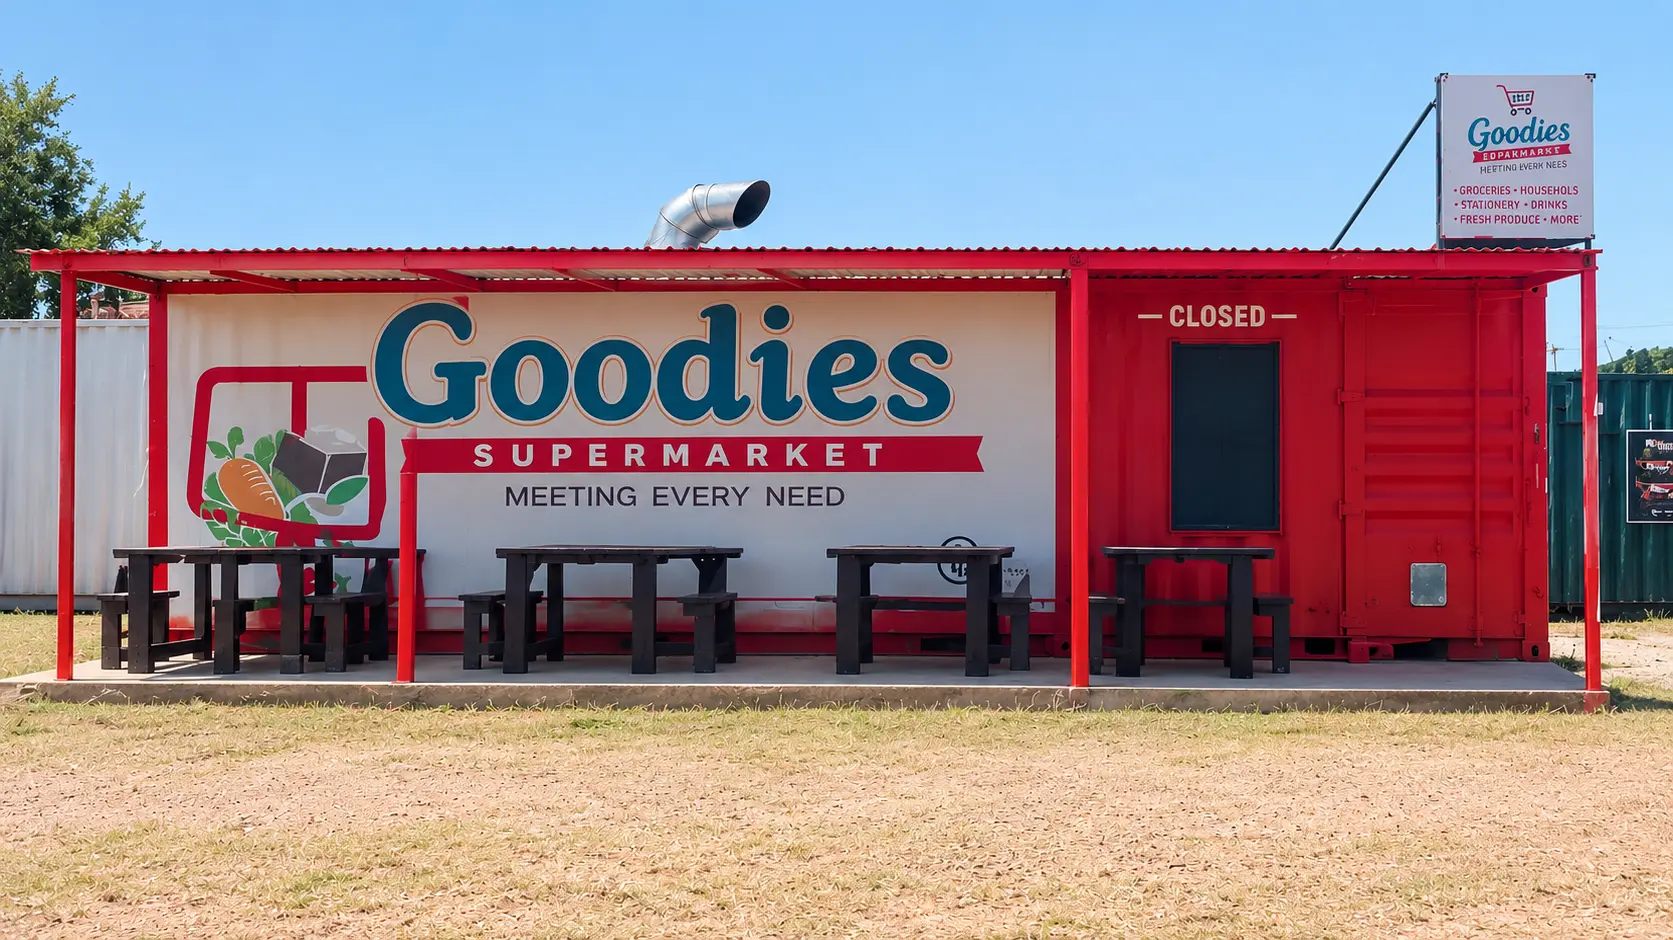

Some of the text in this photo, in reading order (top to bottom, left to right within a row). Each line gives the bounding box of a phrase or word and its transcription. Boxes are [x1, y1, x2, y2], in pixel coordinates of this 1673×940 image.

[1467, 116, 1570, 151] Goodies
[1459, 185, 1579, 195] GROCERIES HOUSEHOLS
[1461, 200, 1568, 209] STATIONERY DRINKS
[1460, 215, 1491, 224] FRESH
[1494, 215, 1540, 224] PRODUCE
[1169, 304, 1266, 328] CLOSED
[372, 300, 954, 426] Goodies
[473, 443, 884, 468] SUPERMARKET
[505, 485, 846, 508] MEETING EVERY NEED
